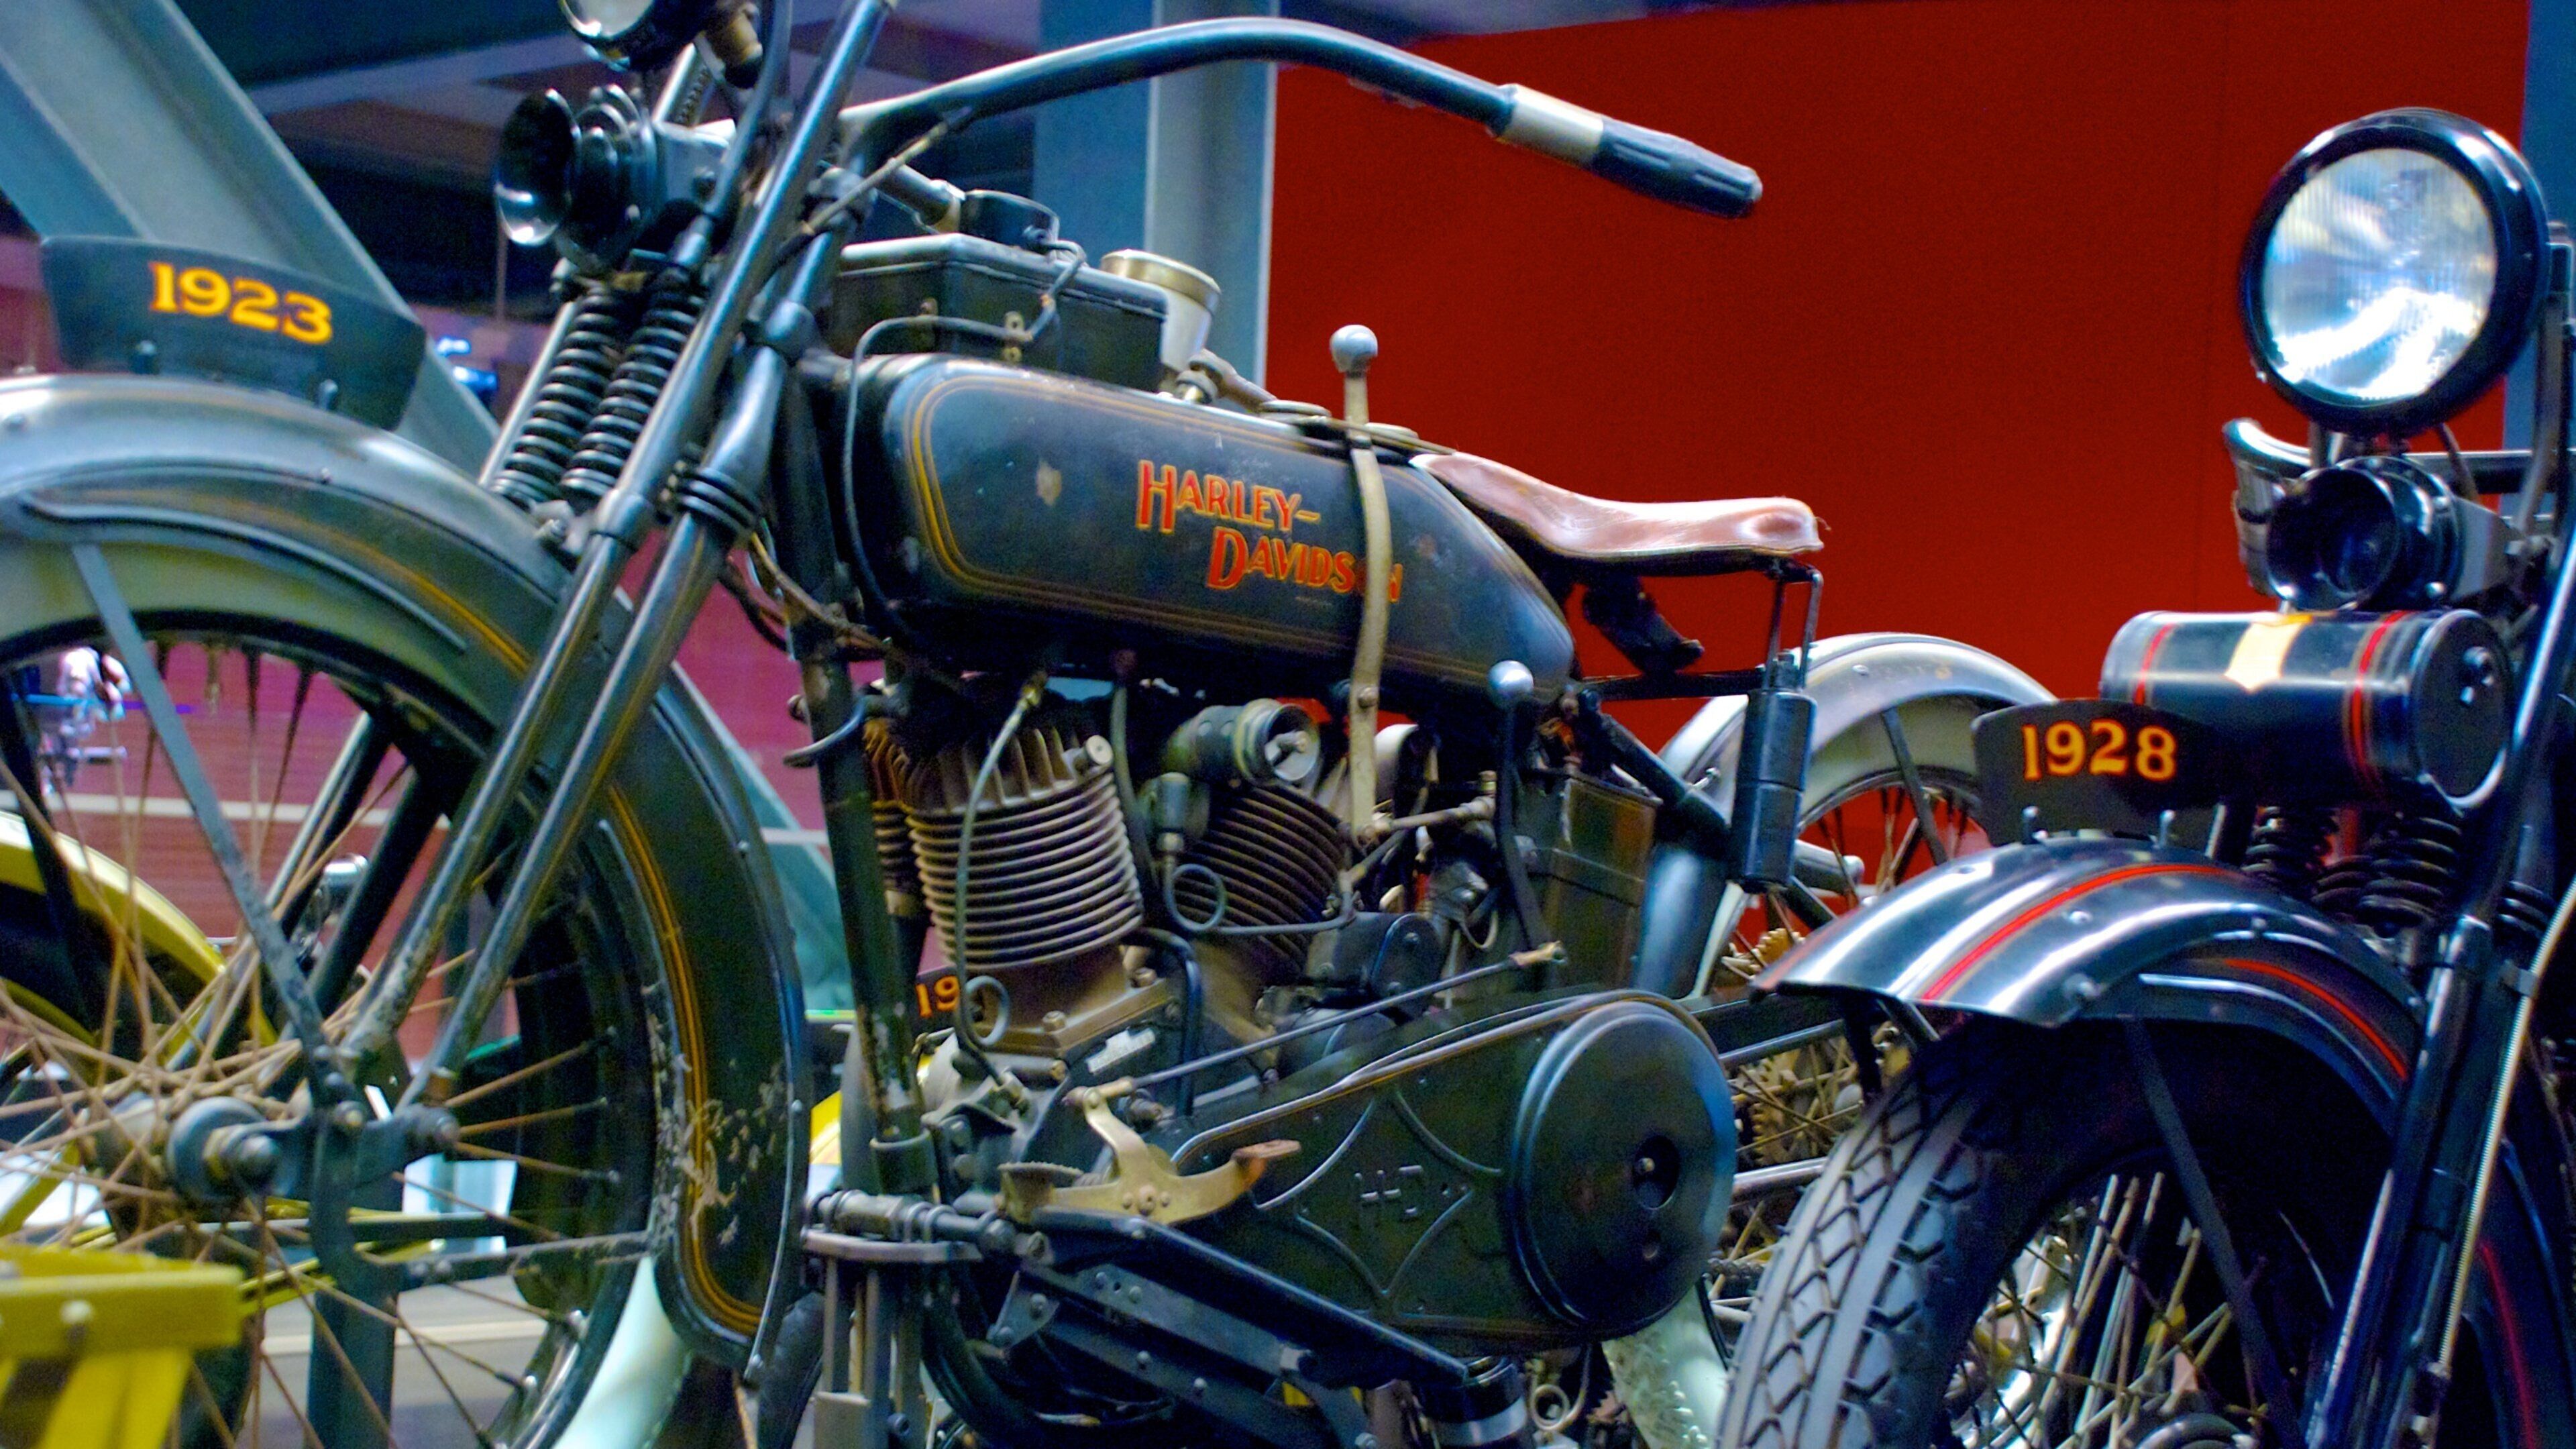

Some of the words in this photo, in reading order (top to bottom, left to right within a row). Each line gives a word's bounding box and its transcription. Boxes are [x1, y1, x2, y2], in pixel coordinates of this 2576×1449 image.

[149, 261, 333, 344] 1923
[1136, 460, 1321, 534] HARLEY-
[2021, 718, 2177, 782] 1928
[916, 975, 959, 1018] 19
